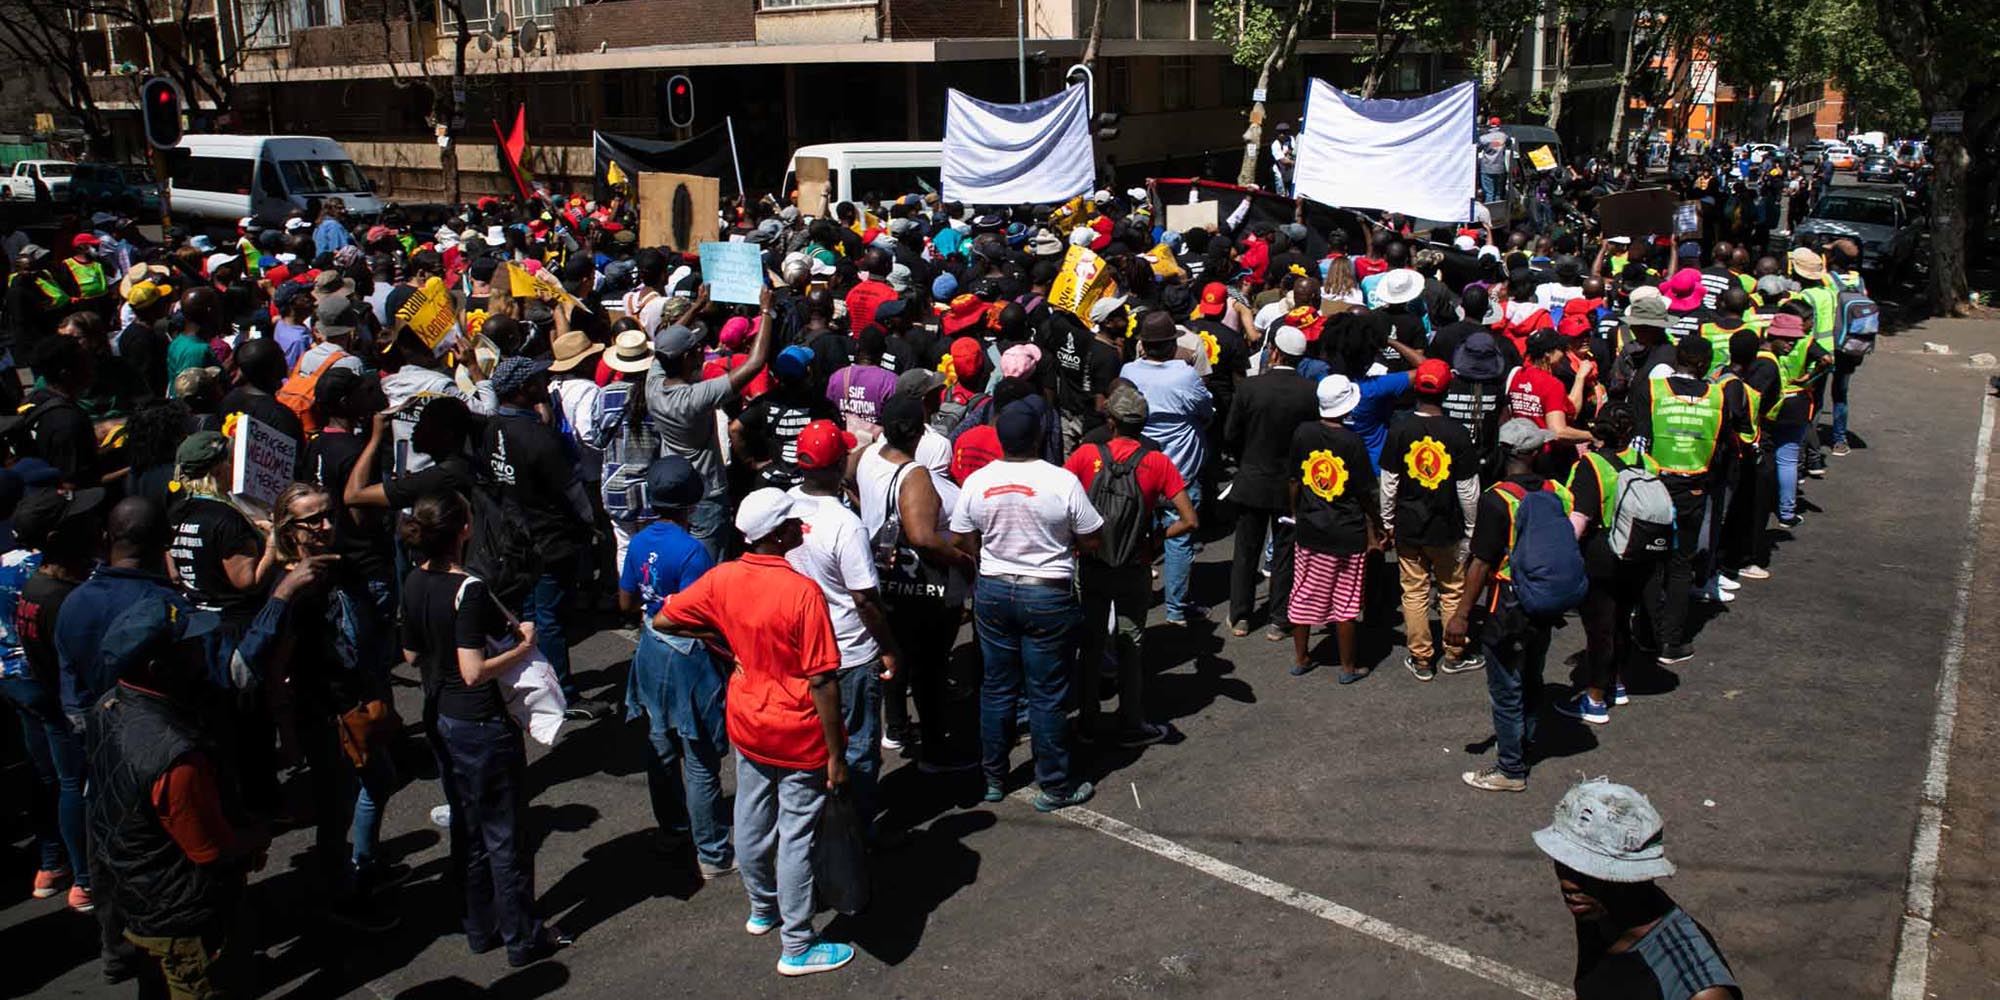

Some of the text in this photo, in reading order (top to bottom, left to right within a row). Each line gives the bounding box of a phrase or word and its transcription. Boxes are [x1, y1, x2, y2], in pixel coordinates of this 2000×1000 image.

[1057, 350, 1080, 364] CWAO
[849, 385, 865, 399] SAFE
[250, 421, 296, 457] REFUGEES
[249, 440, 292, 480] WELCOME
